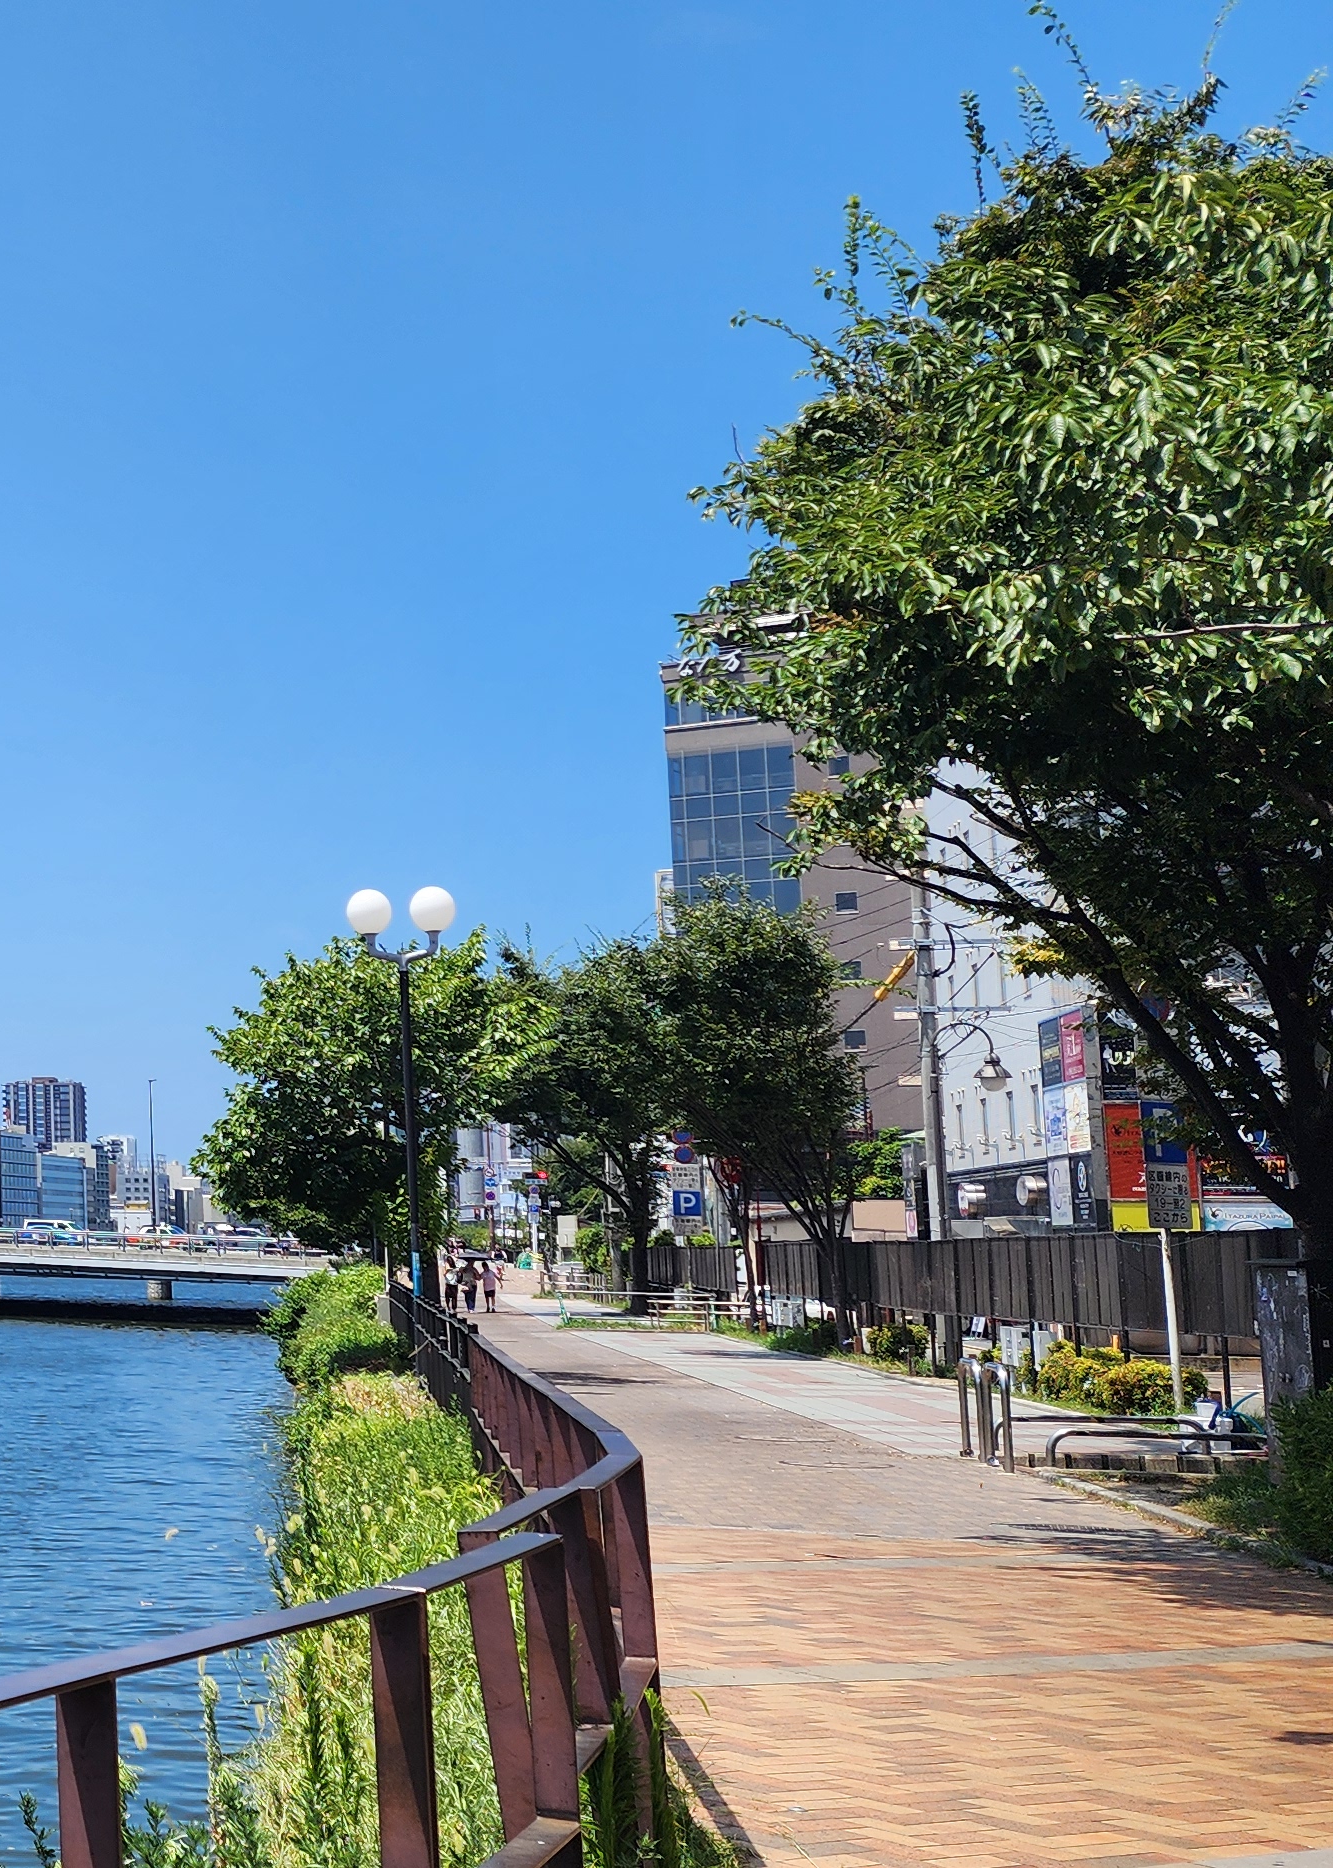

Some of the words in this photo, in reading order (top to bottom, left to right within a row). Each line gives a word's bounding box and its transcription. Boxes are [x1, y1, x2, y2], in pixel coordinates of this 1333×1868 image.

[679, 1193, 696, 1214] P
[1153, 1212, 1188, 1223] ここから
